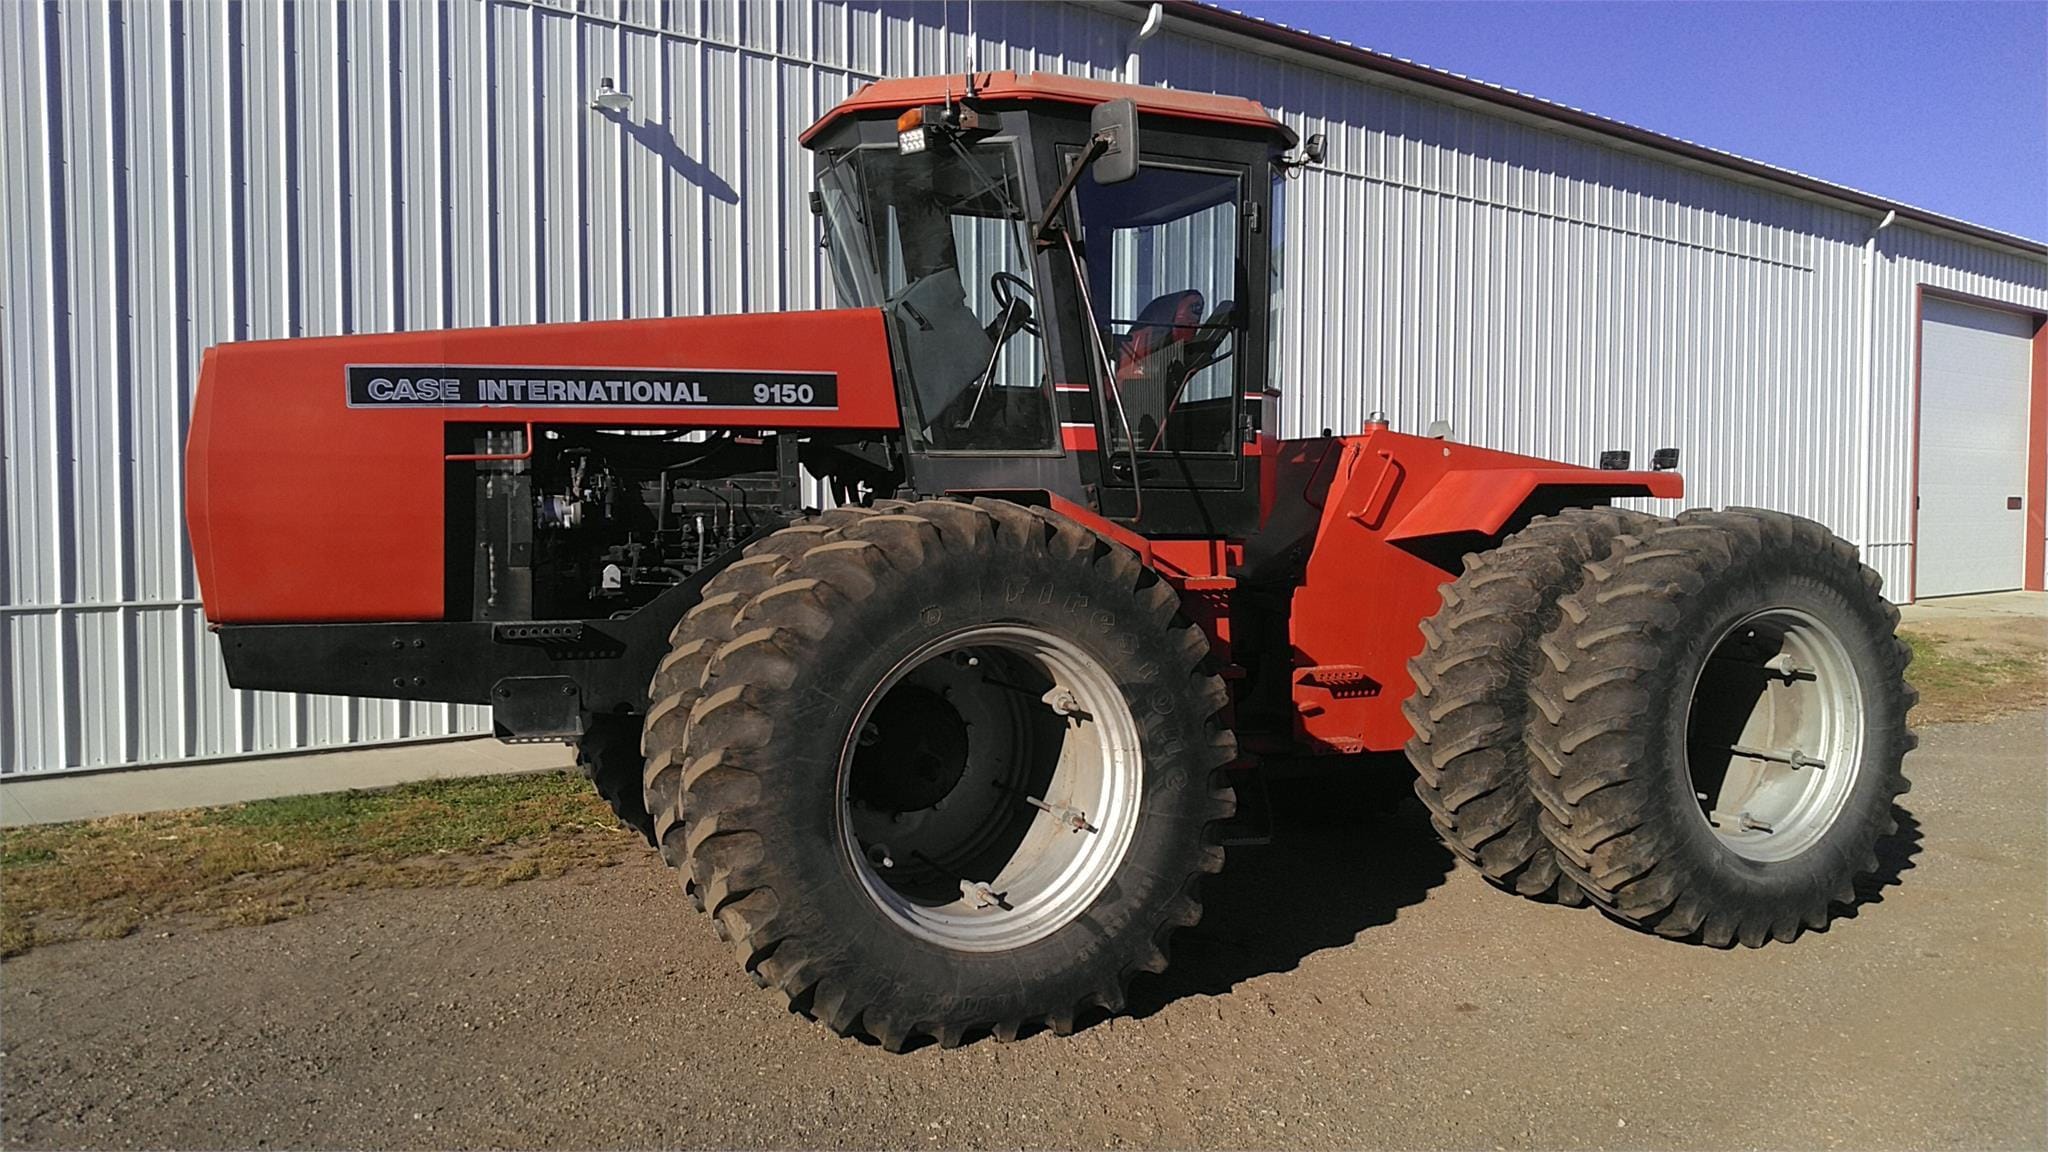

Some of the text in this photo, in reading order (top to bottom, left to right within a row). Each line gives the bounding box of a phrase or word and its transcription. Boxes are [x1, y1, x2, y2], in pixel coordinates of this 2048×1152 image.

[367, 378, 815, 404] CASE INTERNATIONAL 9150
